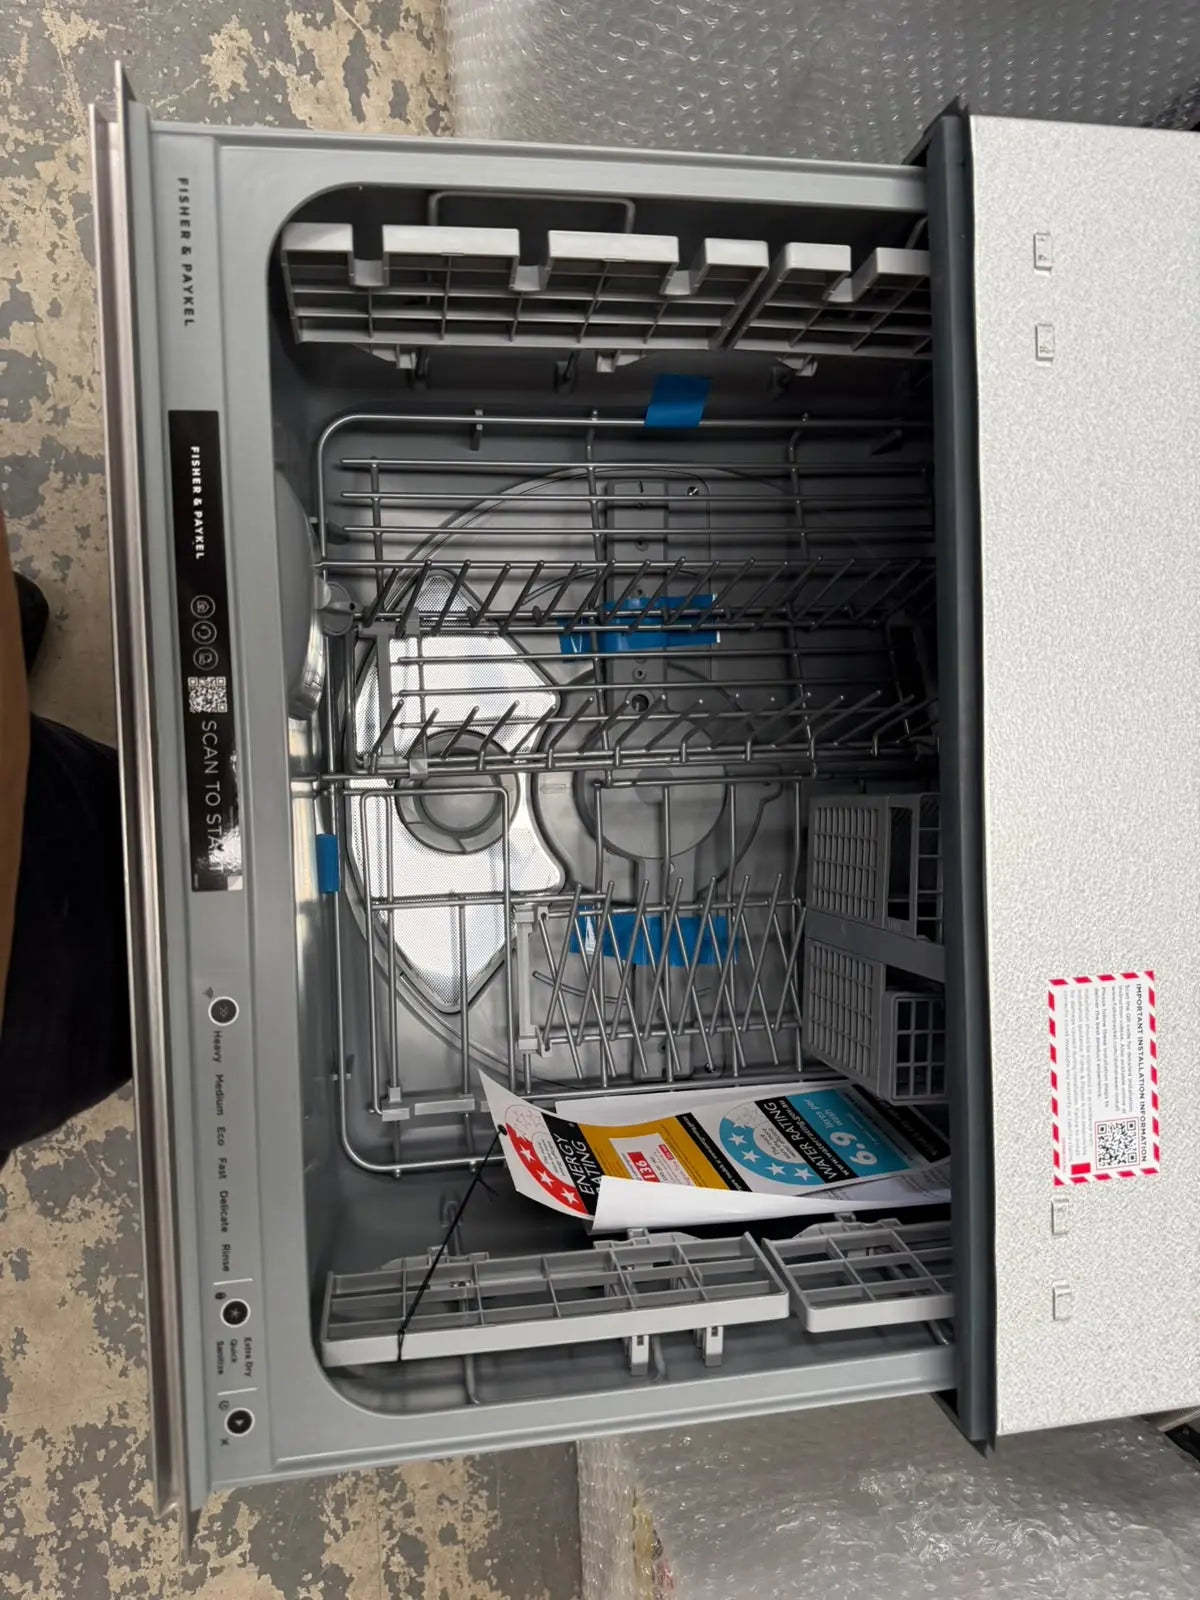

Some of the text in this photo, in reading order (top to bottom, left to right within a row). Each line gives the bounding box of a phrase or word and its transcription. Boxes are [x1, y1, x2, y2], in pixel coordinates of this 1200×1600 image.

[177, 177, 195, 327] FISHER & PAYKEL
[190, 446, 205, 560] FISHER & PAYKEL
[201, 720, 219, 774] SCAN
[205, 780, 221, 807] TO
[1125, 1012, 1131, 1022] QR
[1135, 983, 1147, 1162] IMPORTANT INSTALLATION INFORMATION
[213, 1030, 231, 1272] Heavy Medium Eco Fast Delicate Rinse
[553, 1133, 595, 1195] ENERGY
[764, 1101, 834, 1180] WATER RATING
[779, 1099, 850, 1176] www.waterrating.gov.au
[830, 1131, 878, 1165] 6.9
[635, 1160, 651, 1180] 136
[244, 1337, 253, 1377] Extra Dry
